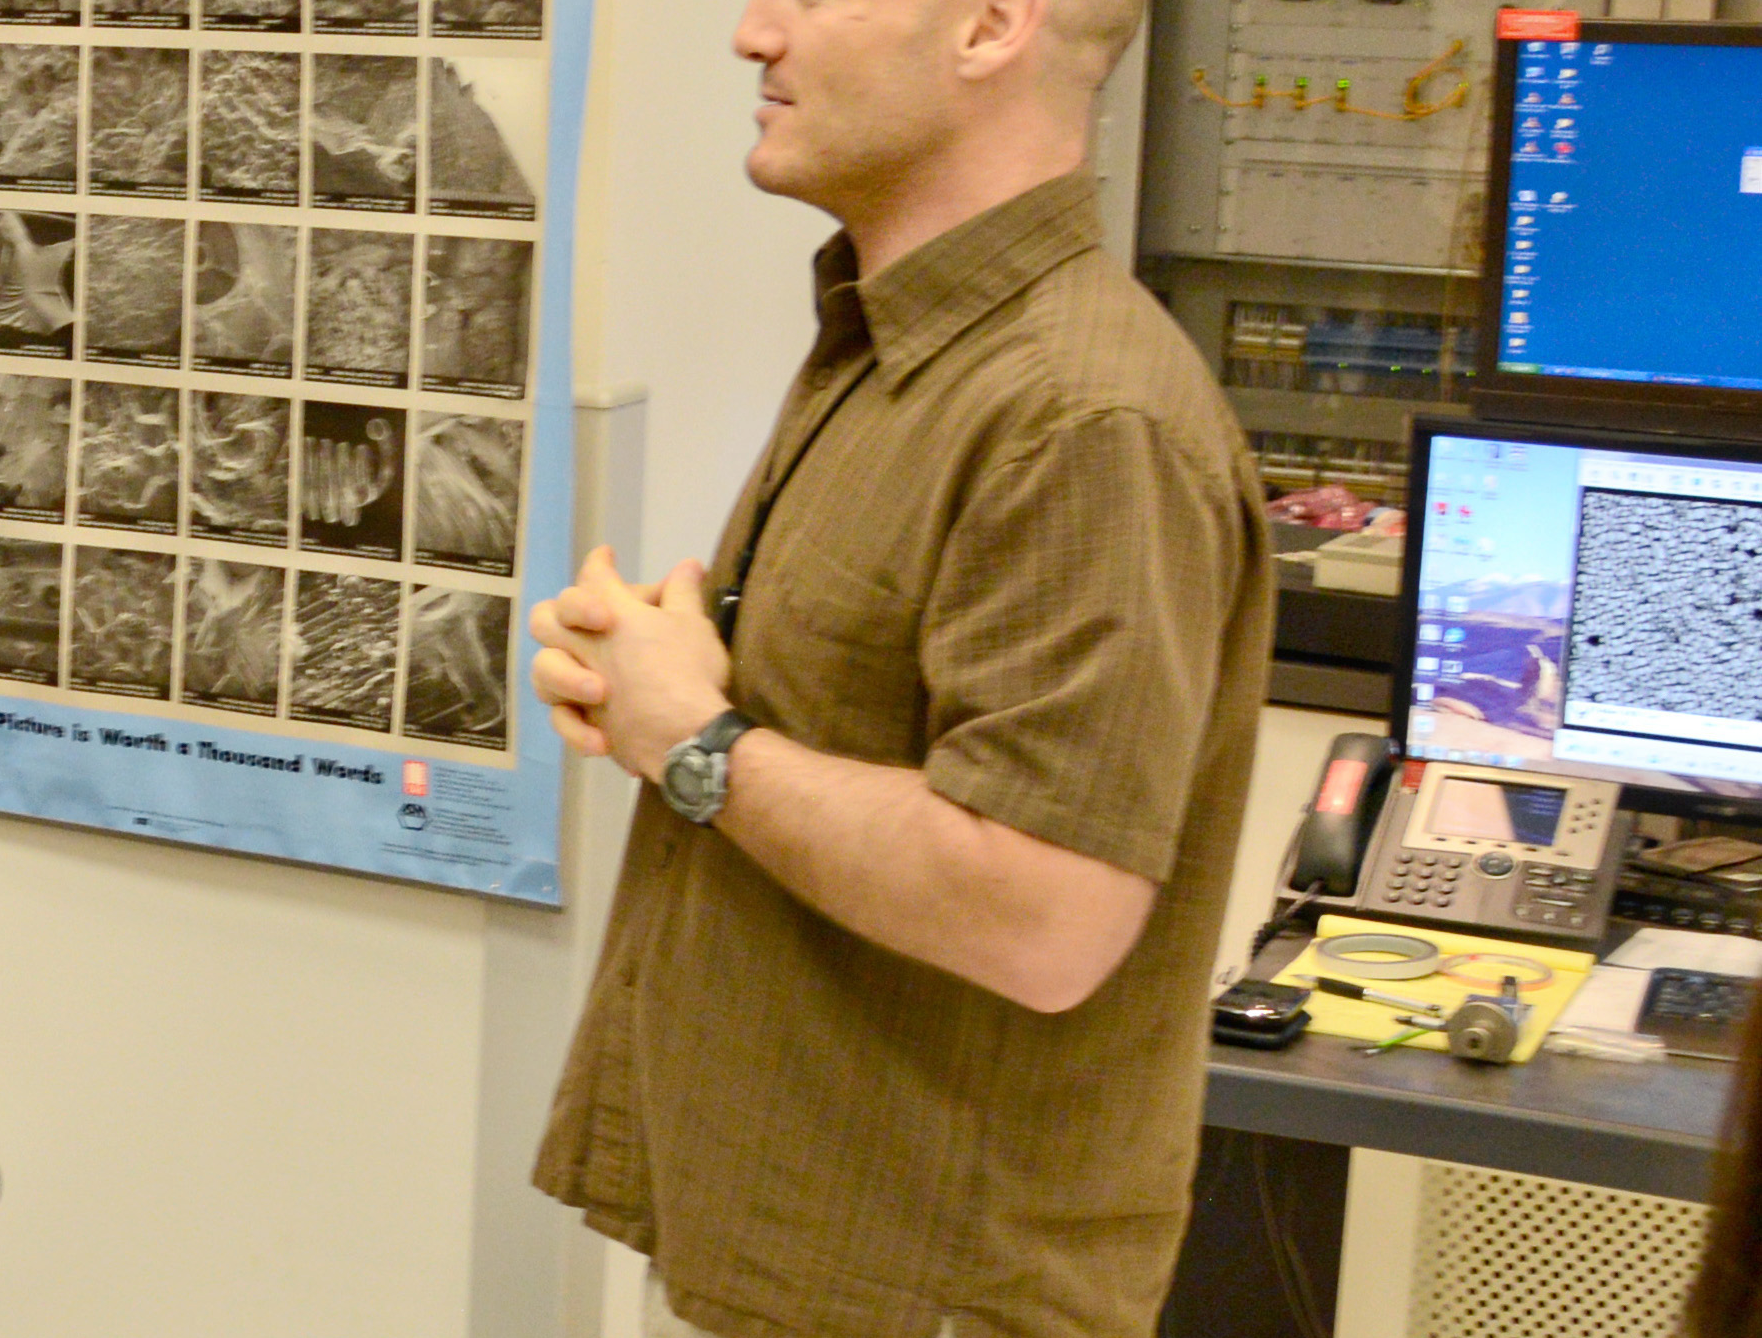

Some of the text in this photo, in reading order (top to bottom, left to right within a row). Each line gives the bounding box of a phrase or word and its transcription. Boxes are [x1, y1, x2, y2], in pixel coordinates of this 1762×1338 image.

[71, 723, 93, 743] is
[98, 727, 169, 753] Worth
[175, 741, 191, 756] a
[197, 741, 305, 773] Thousand
[311, 757, 385, 785] Words
